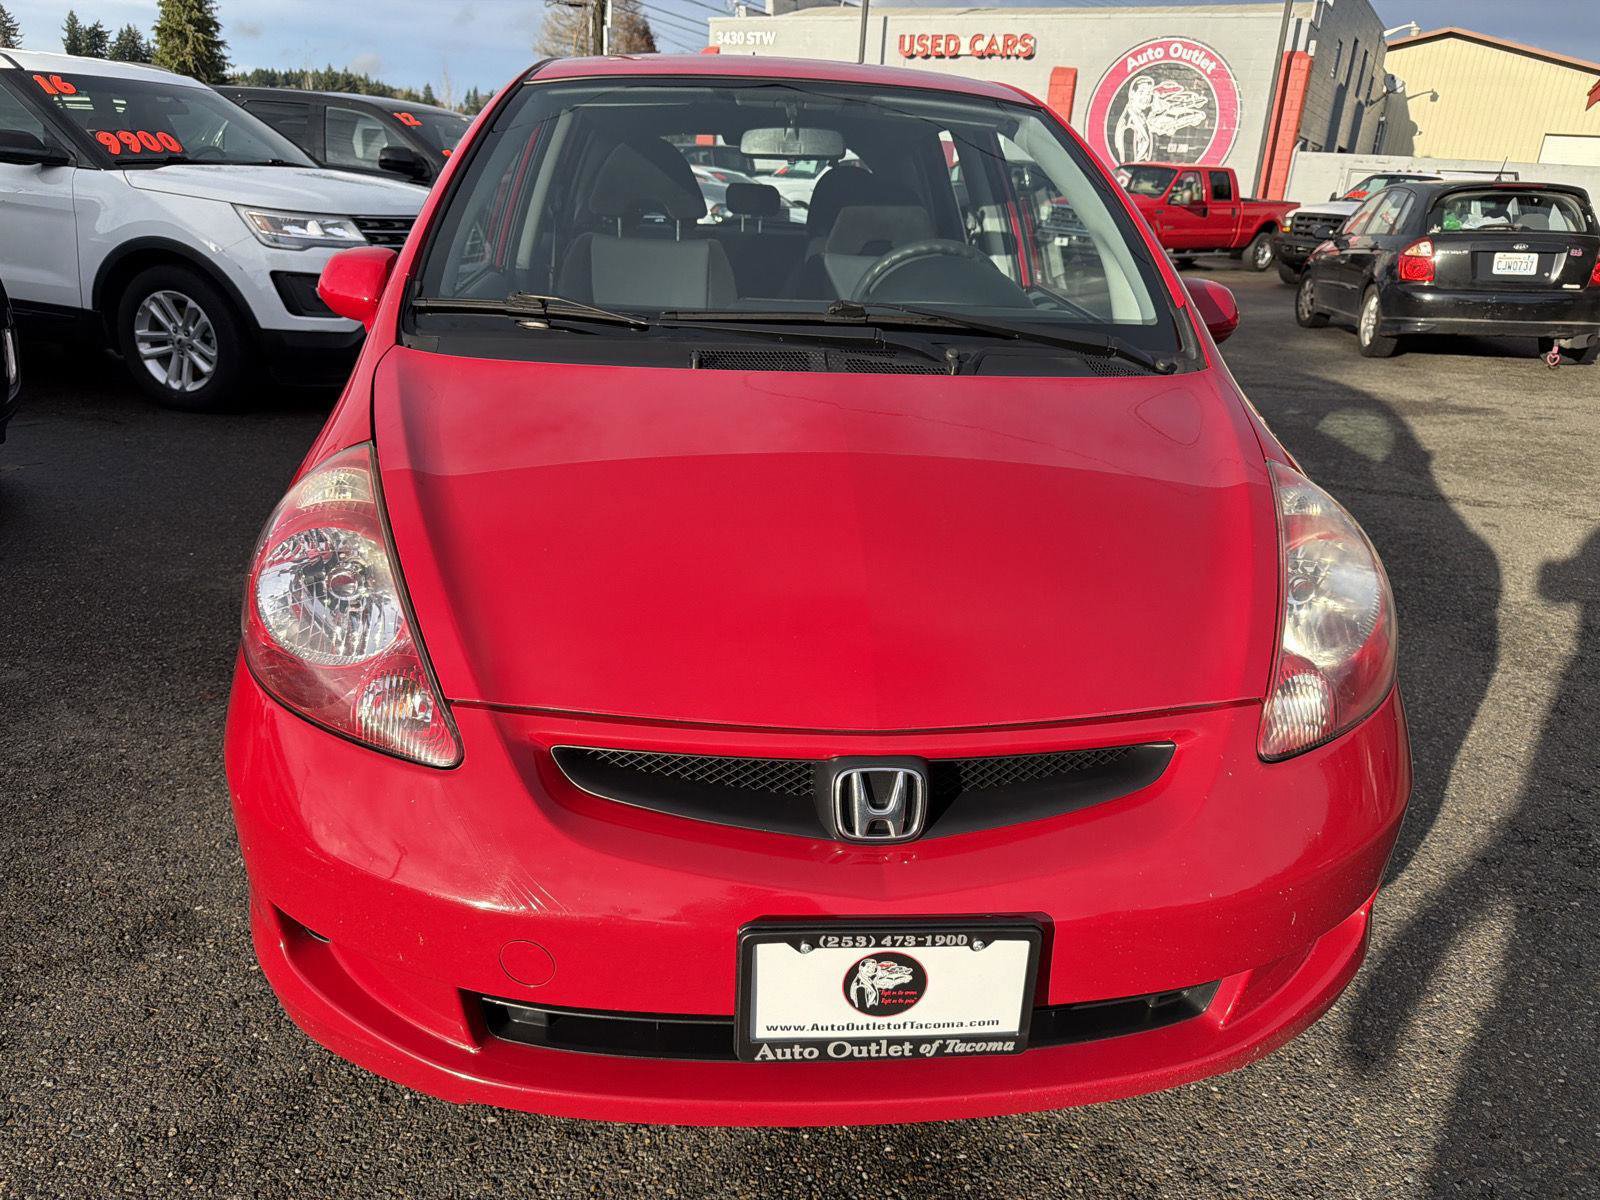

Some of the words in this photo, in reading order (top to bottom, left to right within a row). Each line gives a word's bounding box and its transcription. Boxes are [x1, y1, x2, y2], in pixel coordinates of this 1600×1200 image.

[717, 31, 745, 45] 3430
[898, 34, 961, 59] USED
[969, 33, 1036, 60] CARS
[1126, 47, 1165, 72] Auto
[1169, 43, 1217, 75] Outlet
[33, 74, 76, 95] 16
[393, 112, 423, 127] 12
[95, 130, 183, 155] 9900
[1496, 260, 1534, 272] CJW0737
[818, 935, 876, 948] (253)
[881, 934, 968, 947] 473-1900
[766, 1018, 1000, 1032] www.AutoOutletofTacoma.com
[754, 1043, 819, 1061] Auto
[827, 1039, 912, 1058] Outlet
[919, 1039, 942, 1057] of
[944, 1039, 1015, 1053] Tacoma
